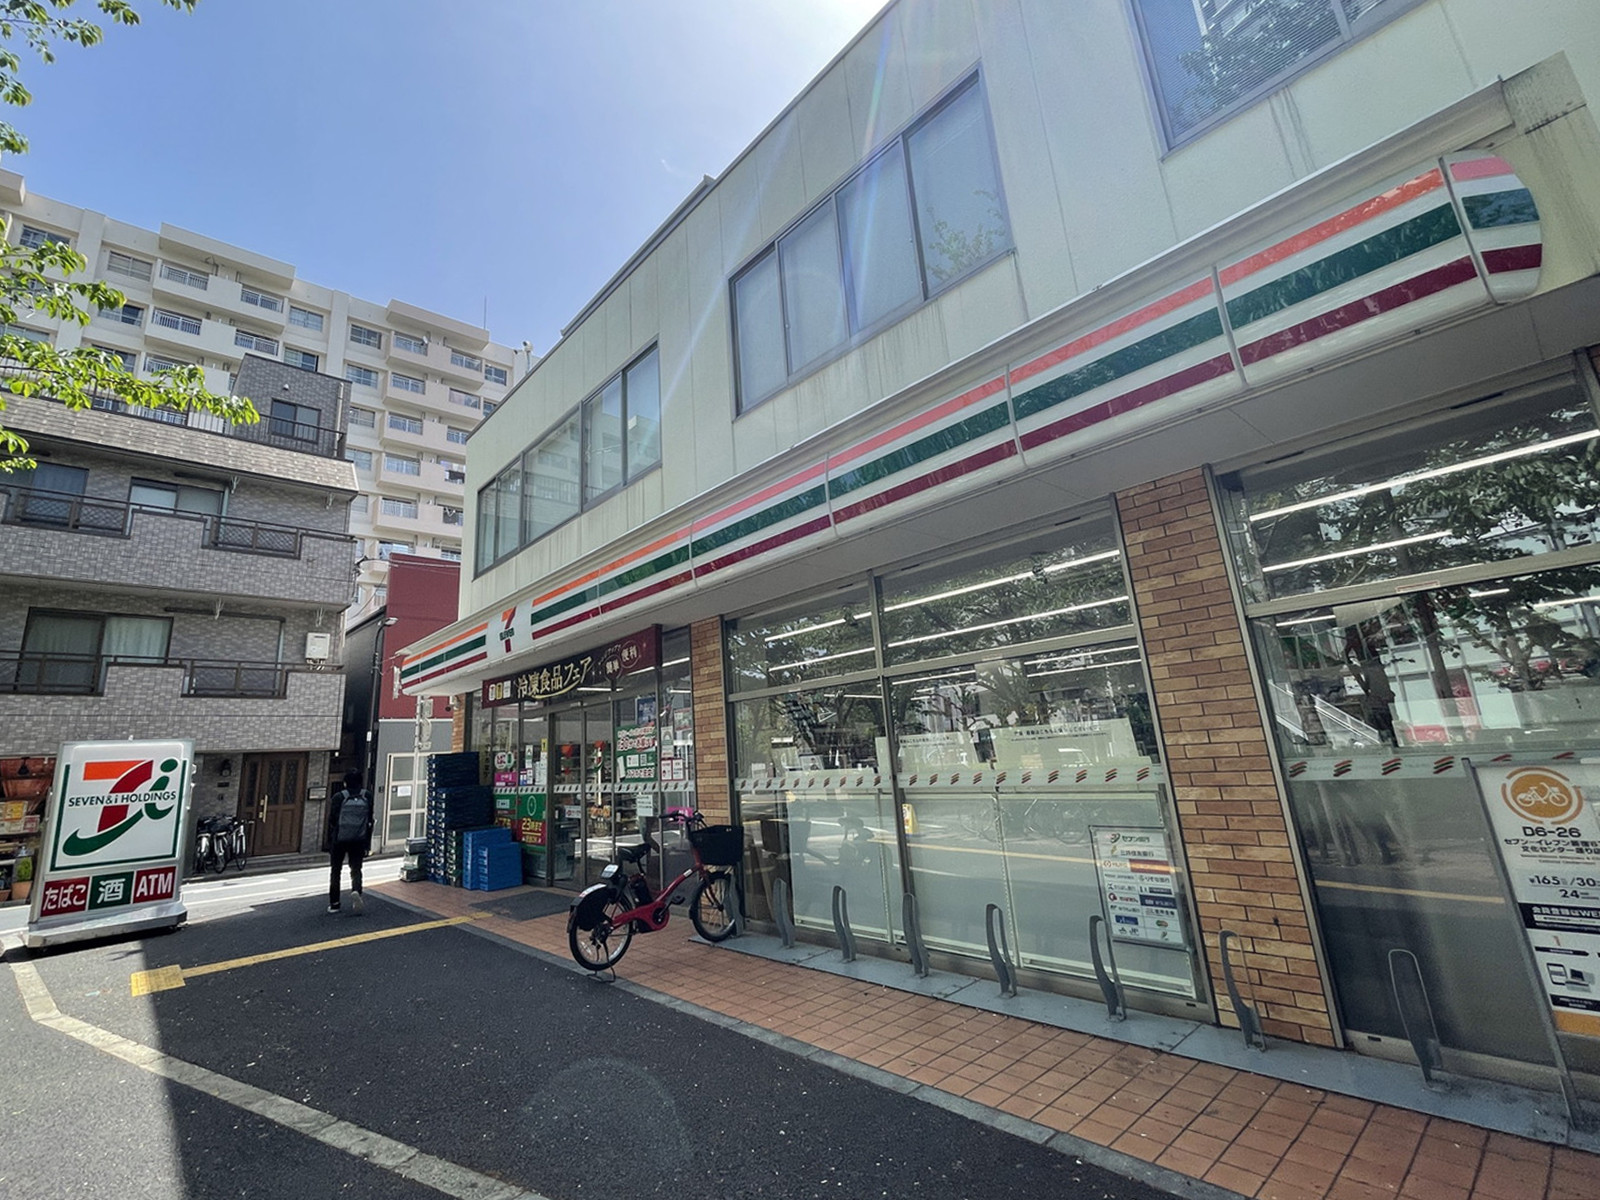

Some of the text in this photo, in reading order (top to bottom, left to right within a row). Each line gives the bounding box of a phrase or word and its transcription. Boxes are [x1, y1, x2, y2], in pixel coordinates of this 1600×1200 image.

[501, 605, 517, 653] 7
[517, 656, 592, 699] 冷凍食品フェア
[120, 791, 177, 804] HOLDINGS
[1522, 826, 1582, 838] D6-26
[43, 884, 87, 911] たばこ
[97, 878, 126, 904] 酒
[136, 872, 173, 898] ATM
